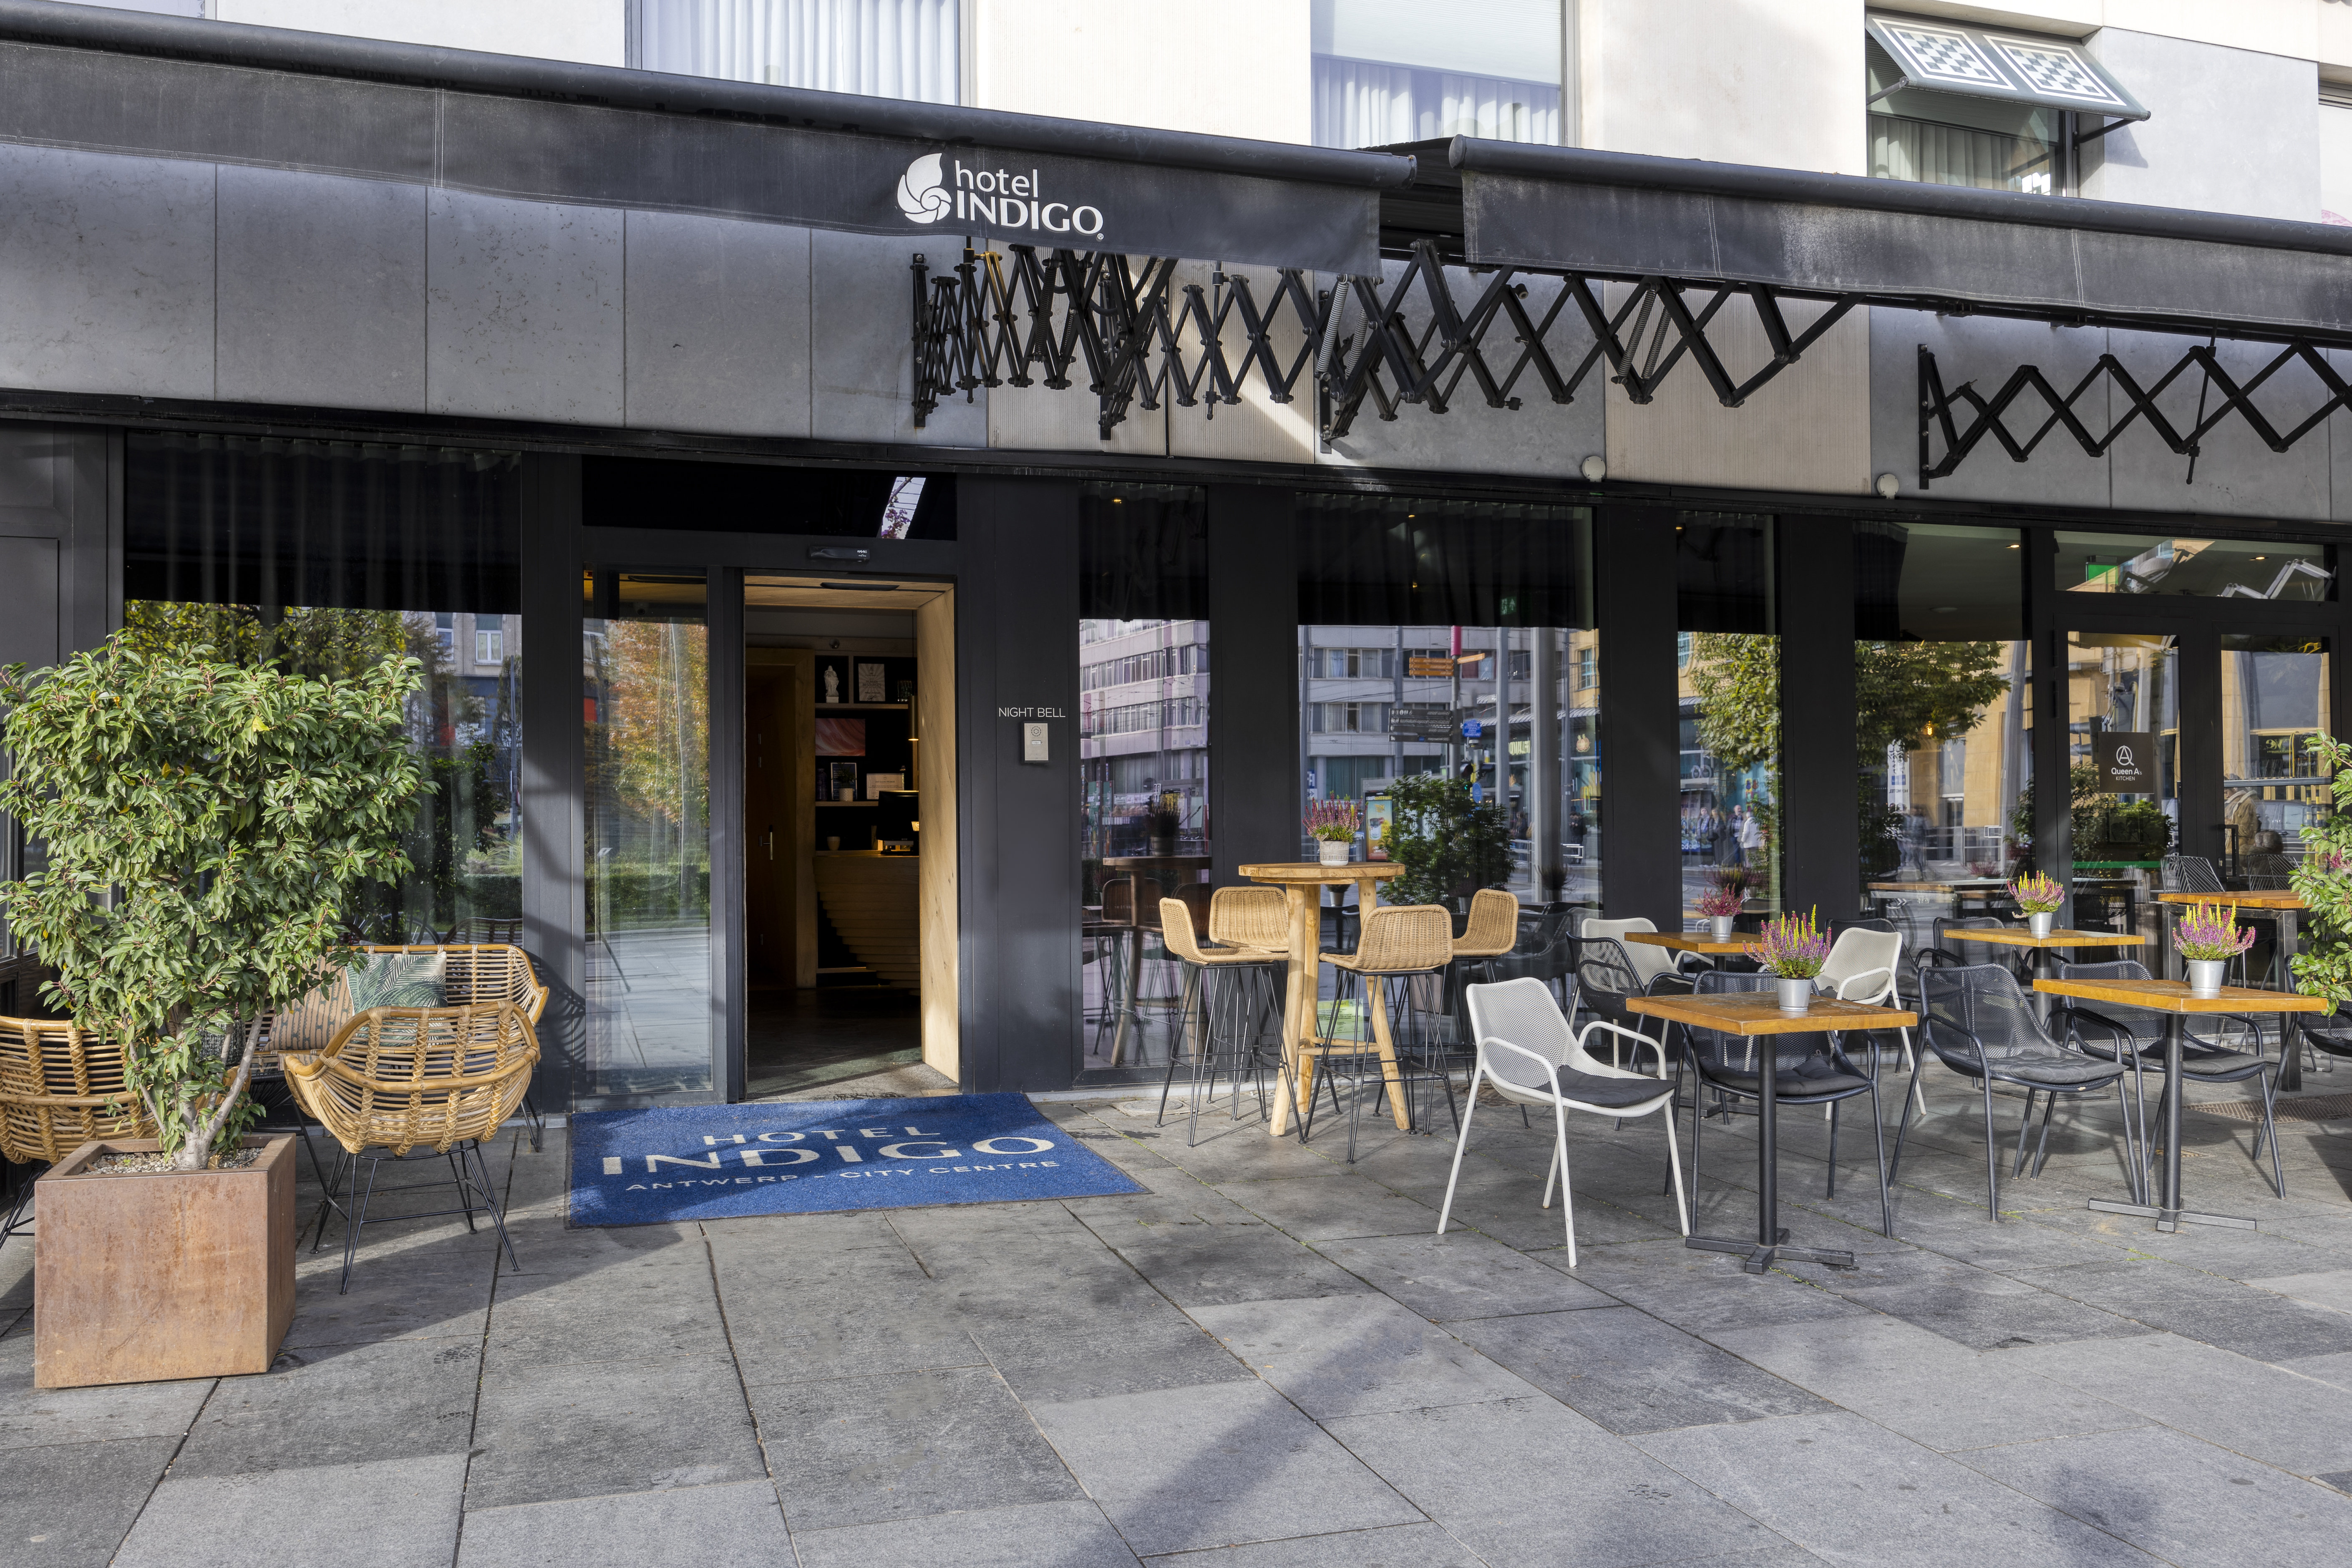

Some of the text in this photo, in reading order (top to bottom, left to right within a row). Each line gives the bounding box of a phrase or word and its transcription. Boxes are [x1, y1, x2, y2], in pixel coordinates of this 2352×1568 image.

[955, 160, 1038, 198] hotel
[999, 707, 1066, 717] NIGHT BELL
[703, 1127, 940, 1145] HOTEL
[602, 1137, 1055, 1175] INDIGO
[626, 1175, 798, 1191] ANTWERP
[839, 1168, 914, 1178] CITY
[929, 1161, 1060, 1173] CENTRE
